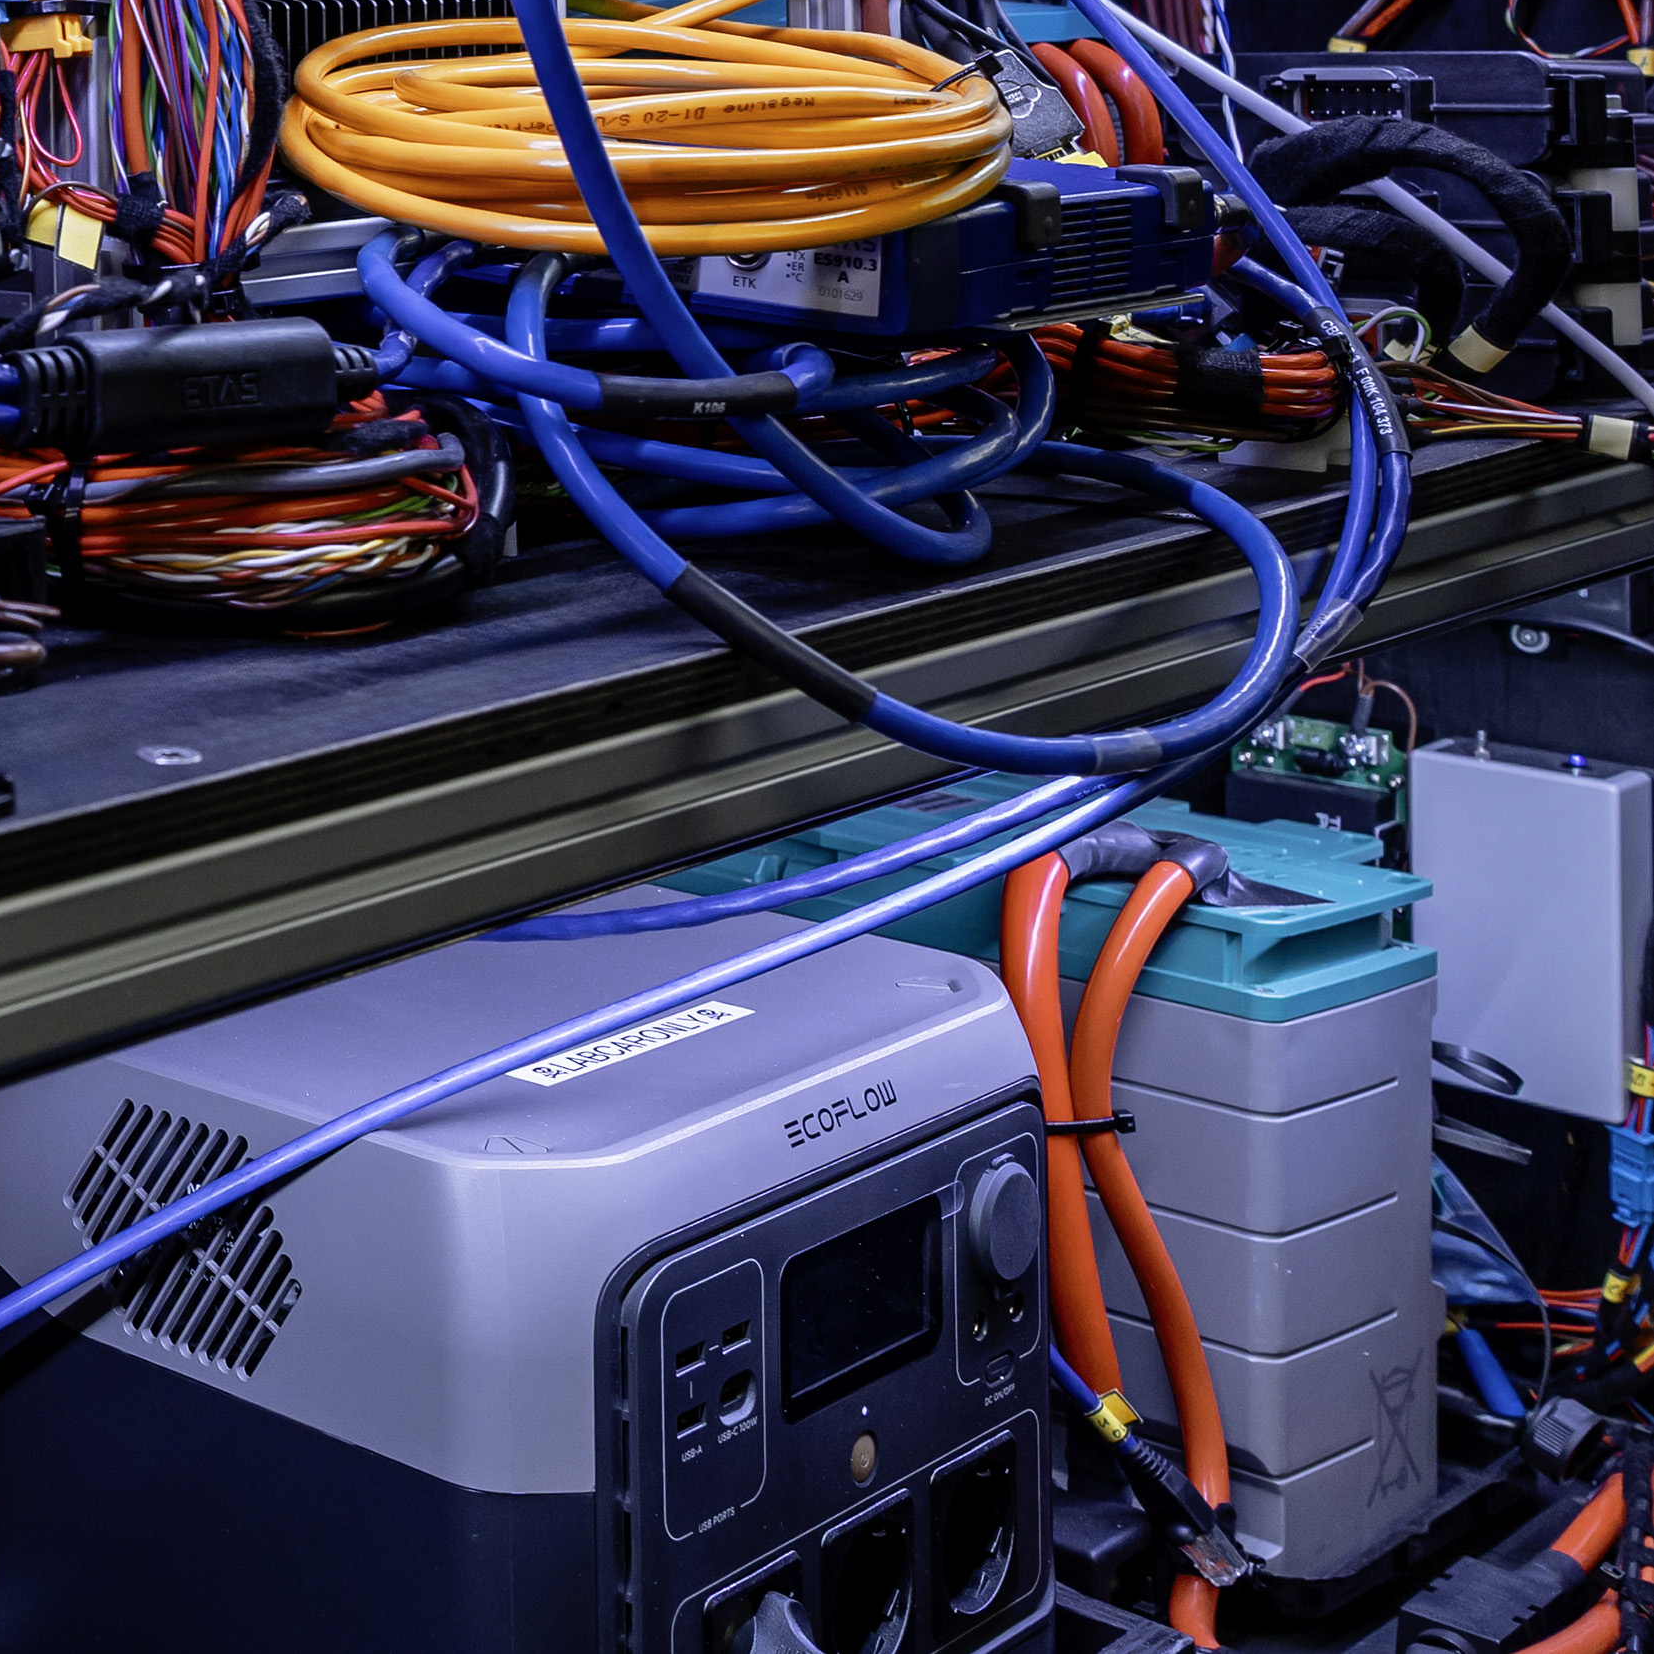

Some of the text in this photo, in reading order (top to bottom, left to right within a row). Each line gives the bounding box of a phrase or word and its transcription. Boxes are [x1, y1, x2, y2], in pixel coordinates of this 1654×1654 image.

[723, 96, 815, 114] MegaLine
[813, 251, 878, 272] ES910.3
[732, 275, 757, 289] ETK
[837, 270, 850, 284] A
[184, 372, 259, 408] ETAS
[784, 1078, 897, 1149] ECOFLOW
[717, 1416, 758, 1444] USB-C 100W
[681, 1445, 703, 1462] USB-A
[698, 1506, 735, 1533] USB PORTS
